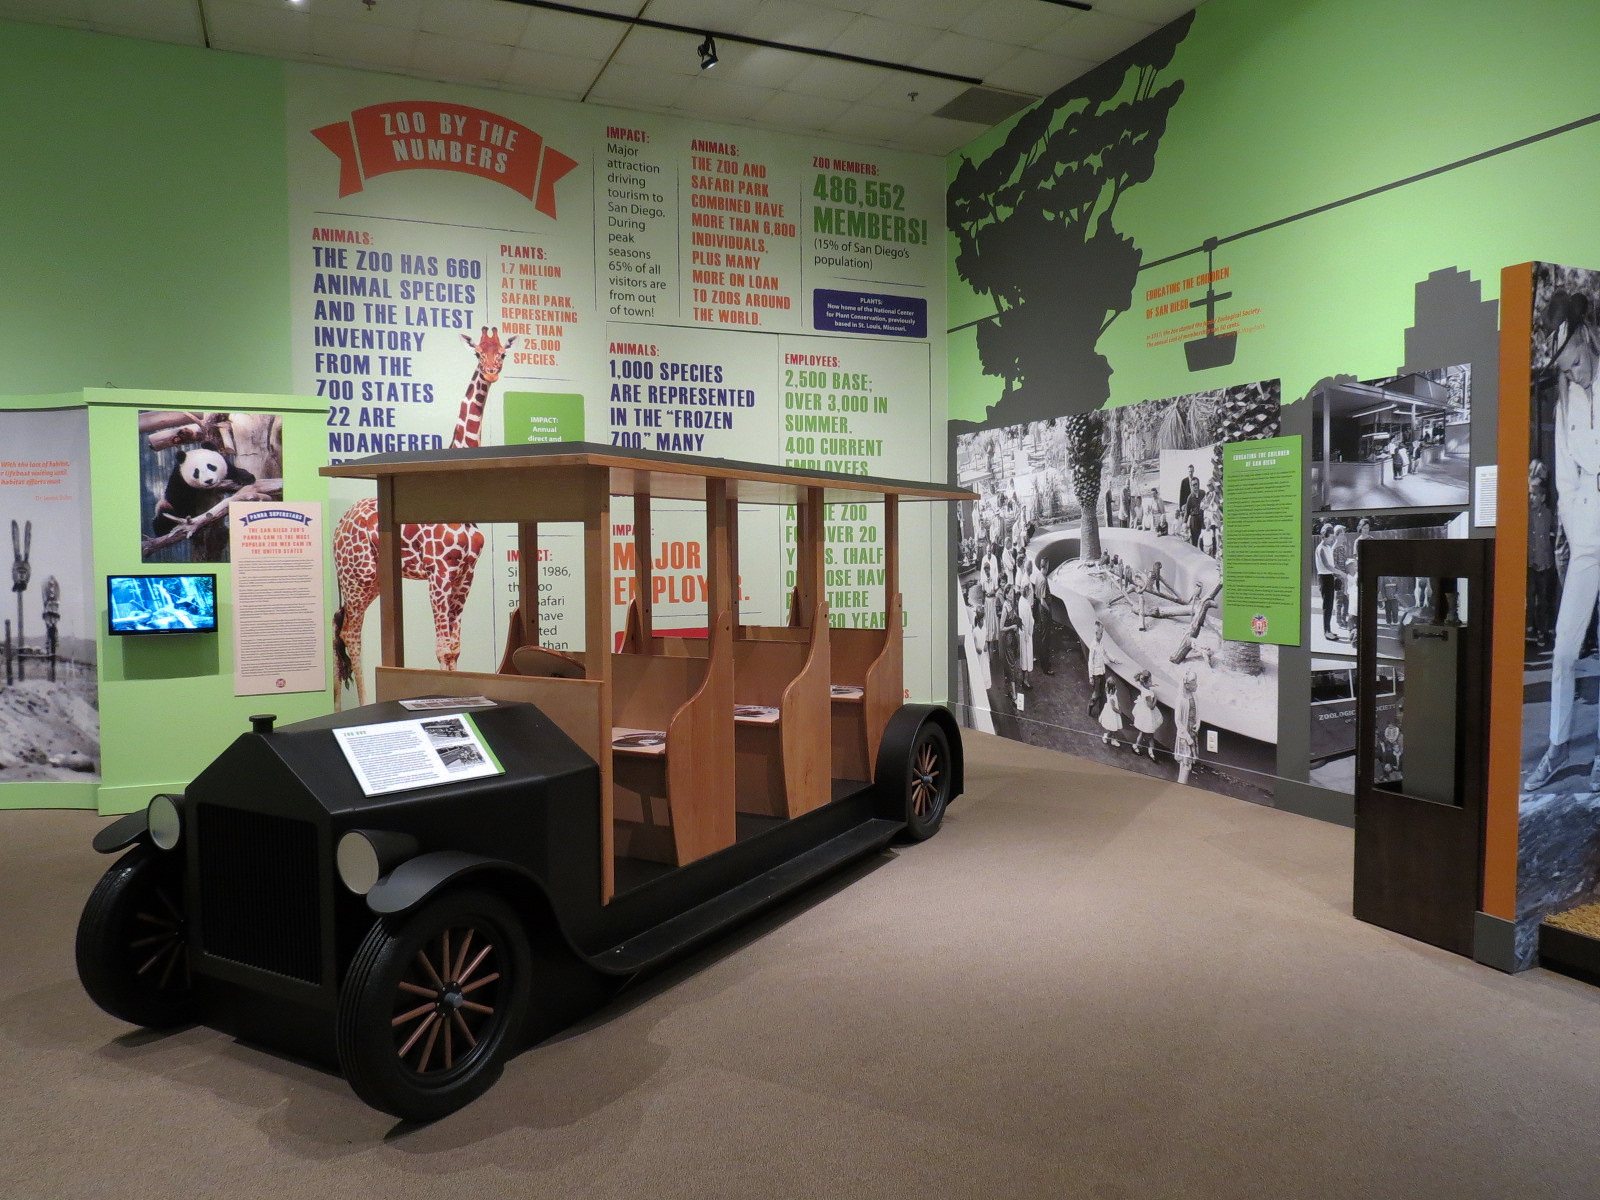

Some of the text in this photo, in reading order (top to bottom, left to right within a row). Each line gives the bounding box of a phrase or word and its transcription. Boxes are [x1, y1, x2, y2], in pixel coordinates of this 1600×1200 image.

[380, 112, 518, 151] ZOO BY THE
[607, 126, 649, 143] IMPACT:
[393, 139, 507, 173] NUMBERS
[608, 143, 638, 157] Major
[691, 139, 739, 156] ANIMALS:
[607, 160, 659, 173] attraction
[692, 156, 766, 178] THE ZOO AND
[813, 157, 879, 176] ZOO MEMBERS:
[608, 173, 645, 188] driving
[692, 175, 768, 197] SAFARI PARK
[608, 189, 663, 202] tourism to
[814, 174, 905, 212] 486,552
[608, 202, 665, 218] San Diego.
[692, 194, 784, 217] COMBINED HAVE
[609, 216, 645, 232] During
[692, 213, 795, 237] MORE THAN 6,800
[814, 205, 927, 248] MEMBERS!
[312, 228, 373, 244] ANIMALS:
[609, 233, 634, 243] peak
[692, 232, 768, 253] INDIVIDUALS.
[501, 245, 546, 260] PLANTS:
[609, 248, 651, 259] seasons
[814, 238, 839, 250] (15%
[842, 242, 852, 251] of
[854, 243, 871, 254] San
[313, 247, 480, 279] THE ZOO HAS 660
[609, 261, 660, 274] 65% of all
[693, 251, 760, 270] PLUS MANY
[815, 256, 872, 270] population)
[502, 263, 561, 277] 1.7 MILLION
[314, 273, 475, 304] ANIMAL SPECIES
[502, 277, 537, 291] AT THE
[609, 276, 666, 289] visitors are
[693, 270, 778, 290] MORE ON LOAN
[1146, 266, 1230, 301] EDUCATING THE CHILDREN
[502, 292, 574, 308] SAFARI PARK,
[610, 289, 656, 303] from out
[693, 288, 790, 309] TO ZOOS AROUND
[315, 300, 473, 329] AND THE LATEST
[502, 308, 577, 323] REPRESENTING
[610, 305, 654, 317] of town!
[693, 307, 761, 325] THE WORLD.
[1146, 299, 1188, 319] OF SAN DIEGO
[502, 322, 562, 336] MORE THAN
[315, 326, 424, 351] INVENTORY
[525, 339, 560, 351] 25,000
[610, 343, 659, 356] ANIMALS:
[316, 353, 412, 376] FROM THE
[514, 353, 558, 366] SPECIES.
[785, 354, 840, 367] EMPLOYEES:
[610, 360, 722, 383] 1,000 SPECIES
[786, 370, 872, 392] 2,500 BASE;
[316, 379, 433, 403] 700 STATES
[611, 384, 754, 407] ARE REPRESENTED
[786, 392, 887, 413] OVER 3,000 IN
[327, 406, 395, 427] 22 ARE
[530, 416, 559, 424] IMPACT:
[611, 408, 626, 426] IN
[634, 408, 662, 427] THE
[786, 415, 852, 434] SUMMER.
[329, 433, 442, 453] NDANGERED
[657, 433, 704, 451] MANY
[786, 437, 883, 456] 400 CURRENT
[841, 505, 866, 521] ZOO
[860, 526, 876, 542] 20
[613, 542, 701, 571] MJOR
[844, 548, 883, 564] (HALF
[543, 567, 570, 577] 1986,
[827, 591, 868, 608] THERE
